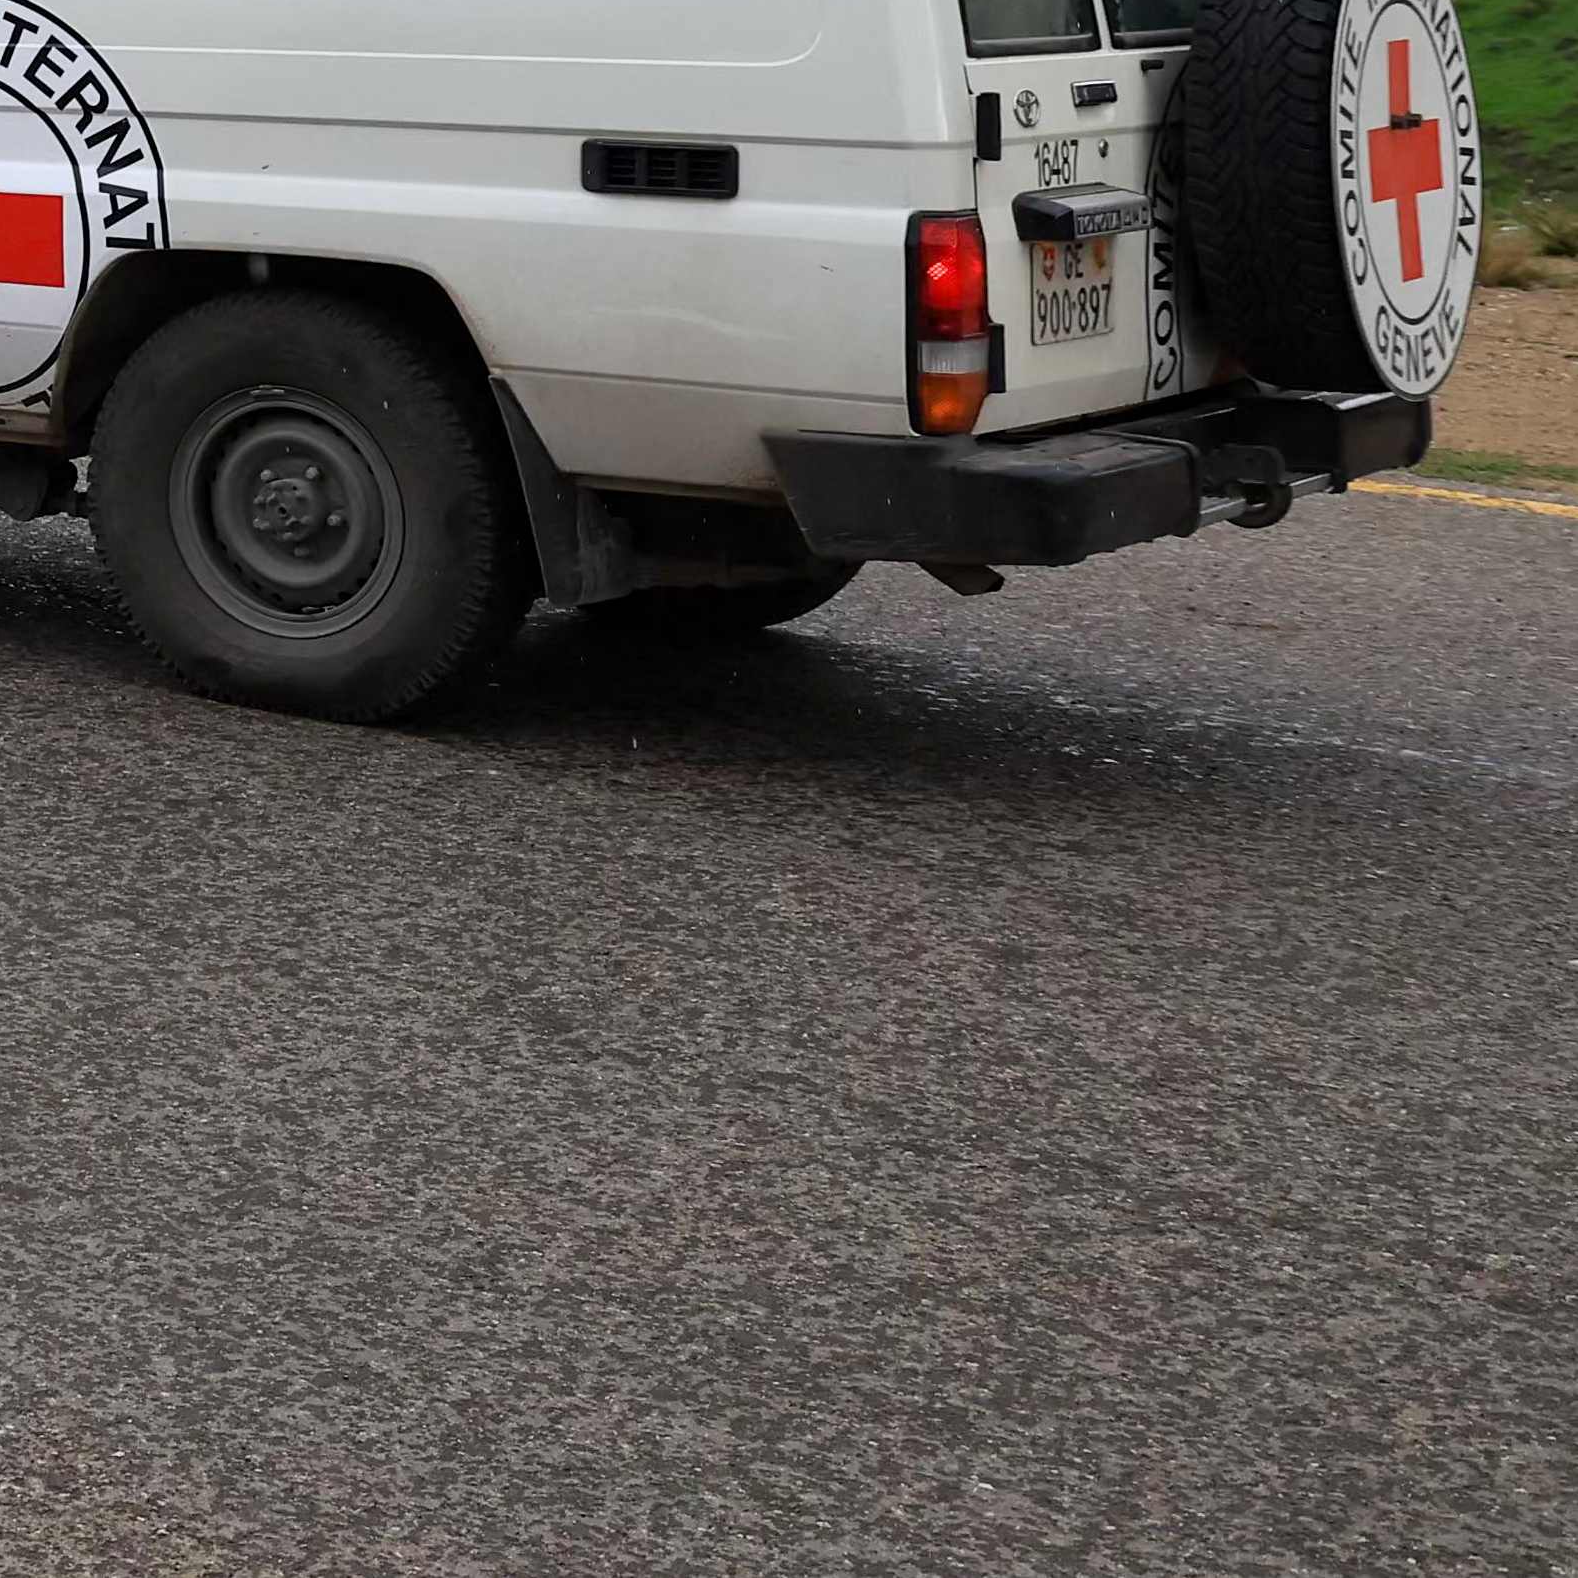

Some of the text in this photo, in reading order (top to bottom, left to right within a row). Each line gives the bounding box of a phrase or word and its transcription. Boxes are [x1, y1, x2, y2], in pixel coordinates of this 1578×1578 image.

[1033, 139, 1079, 187] 16487
[1338, 17, 1366, 286] COMITE
[1064, 243, 1084, 280] GE
[1375, 288, 1459, 383] GENEVE
